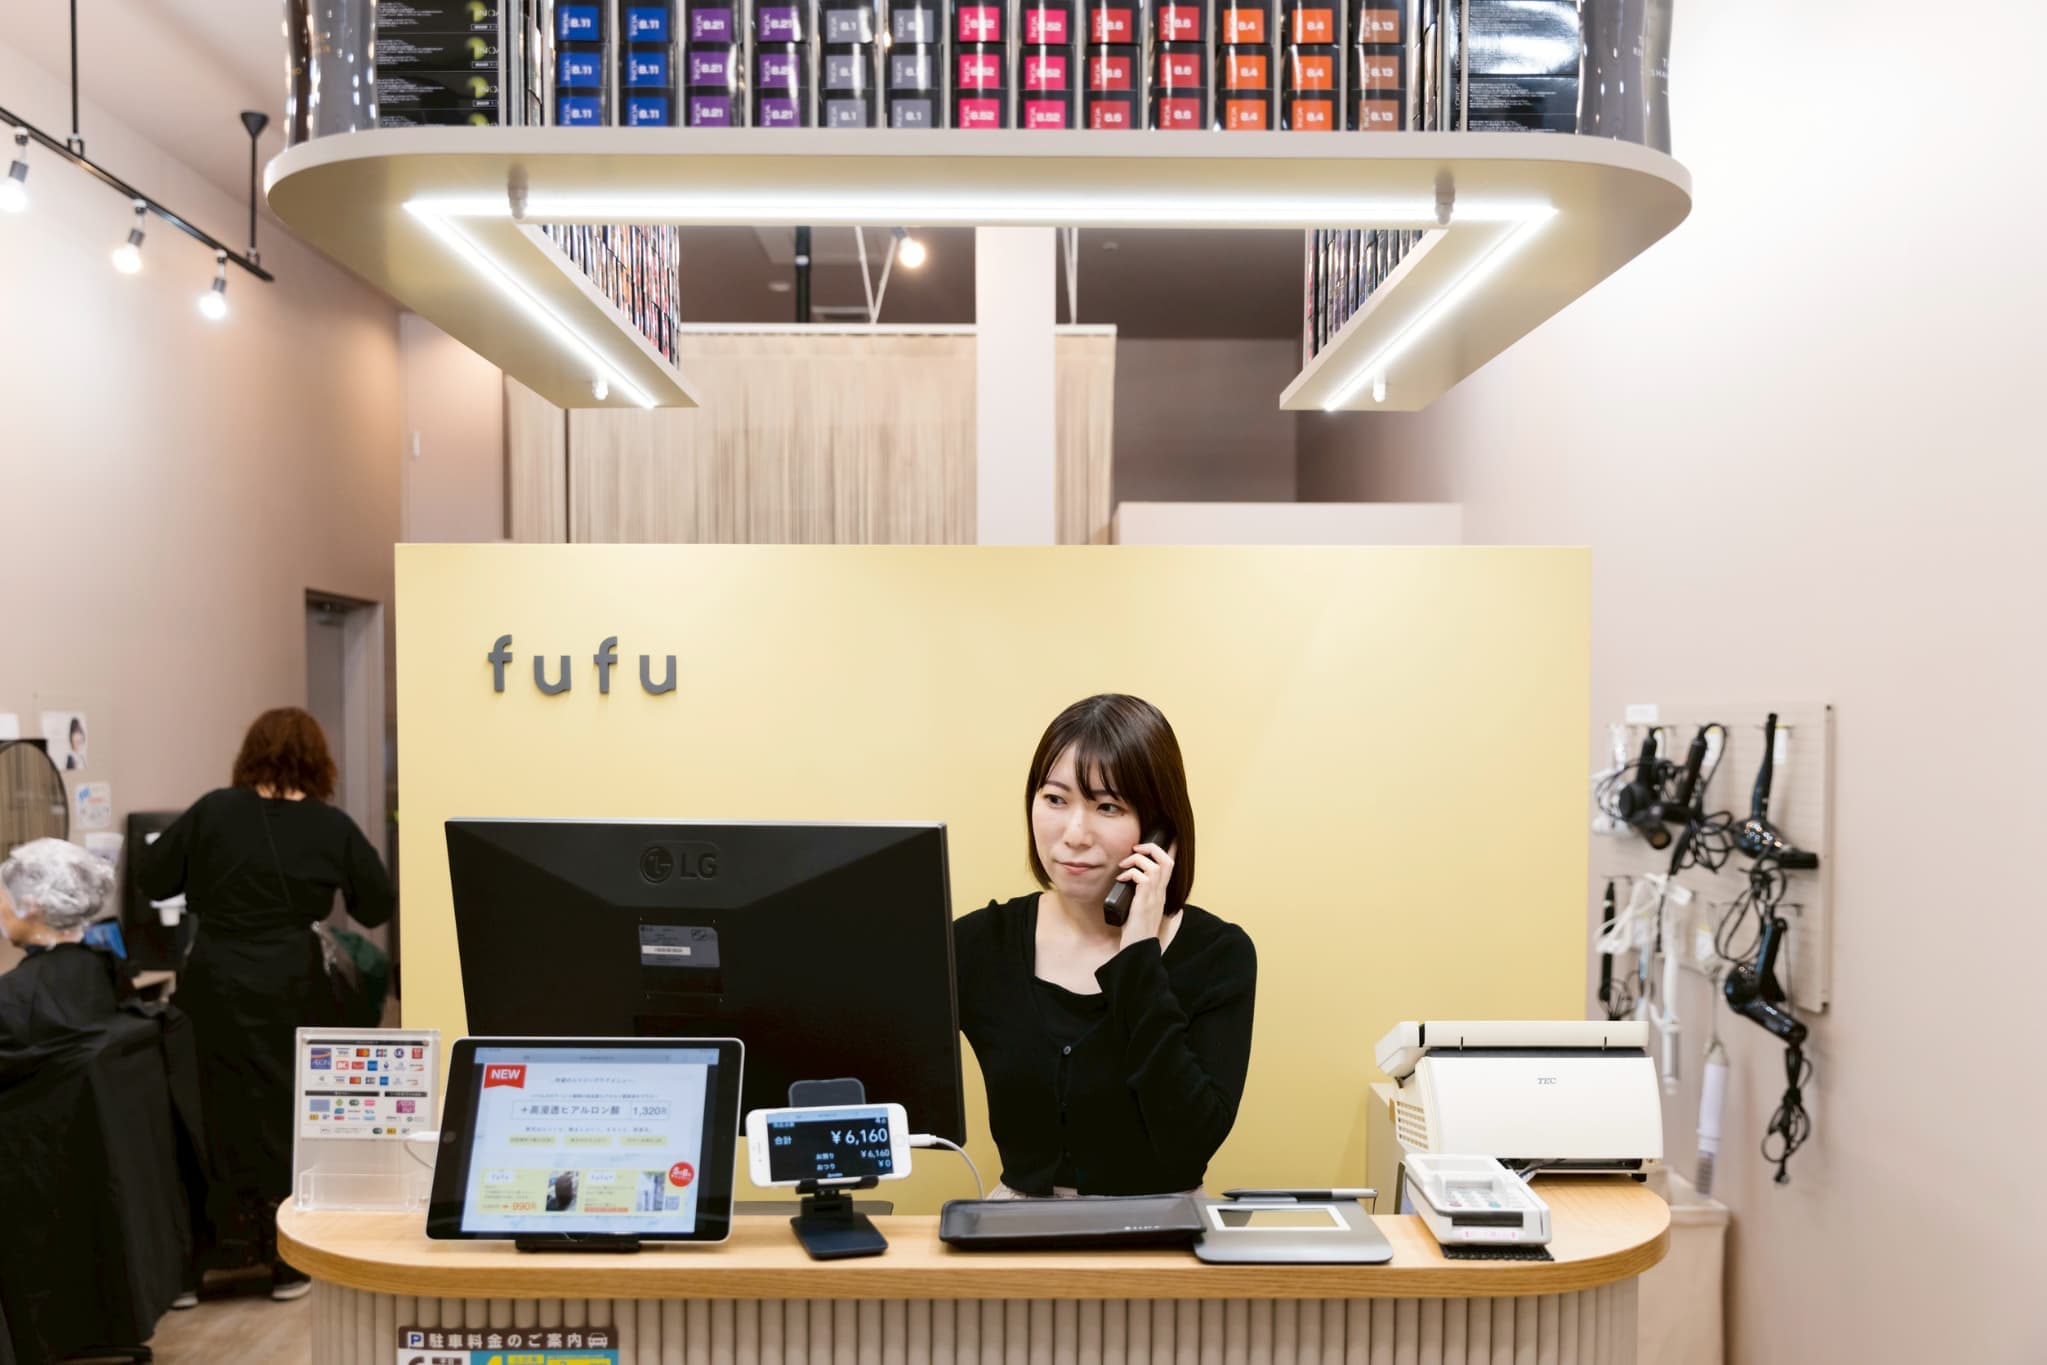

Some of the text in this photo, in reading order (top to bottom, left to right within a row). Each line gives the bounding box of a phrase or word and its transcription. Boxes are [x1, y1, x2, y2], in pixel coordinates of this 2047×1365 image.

[488, 634, 677, 696] fufu
[681, 853, 718, 880] LG
[490, 1069, 521, 1080] NEW
[1537, 1077, 1557, 1085] TEC
[429, 1333, 582, 1349] 駐車料金のご案内
